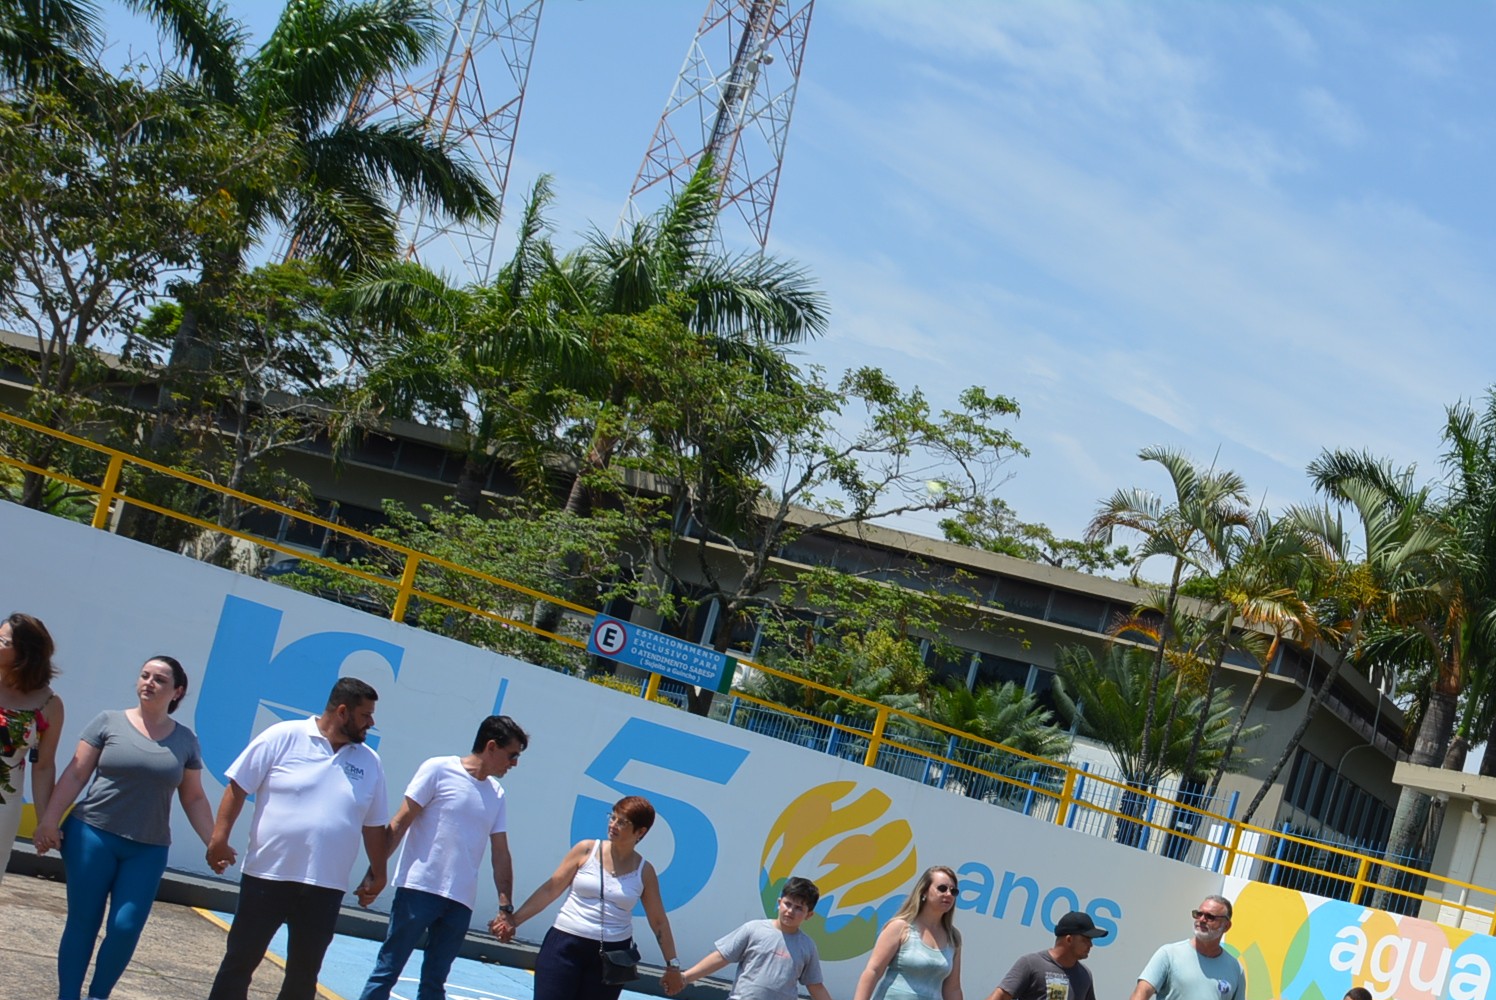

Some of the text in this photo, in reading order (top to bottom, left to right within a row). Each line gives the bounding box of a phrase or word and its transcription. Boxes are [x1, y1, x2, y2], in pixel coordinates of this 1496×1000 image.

[602, 627, 617, 648] E
[636, 628, 721, 662] ESTACIONAMENTO
[633, 638, 717, 671] EXCLUSIVO PARA
[638, 650, 688, 671] ATENDIMENTO
[689, 665, 715, 679] SABESP
[955, 859, 1122, 947] anos
